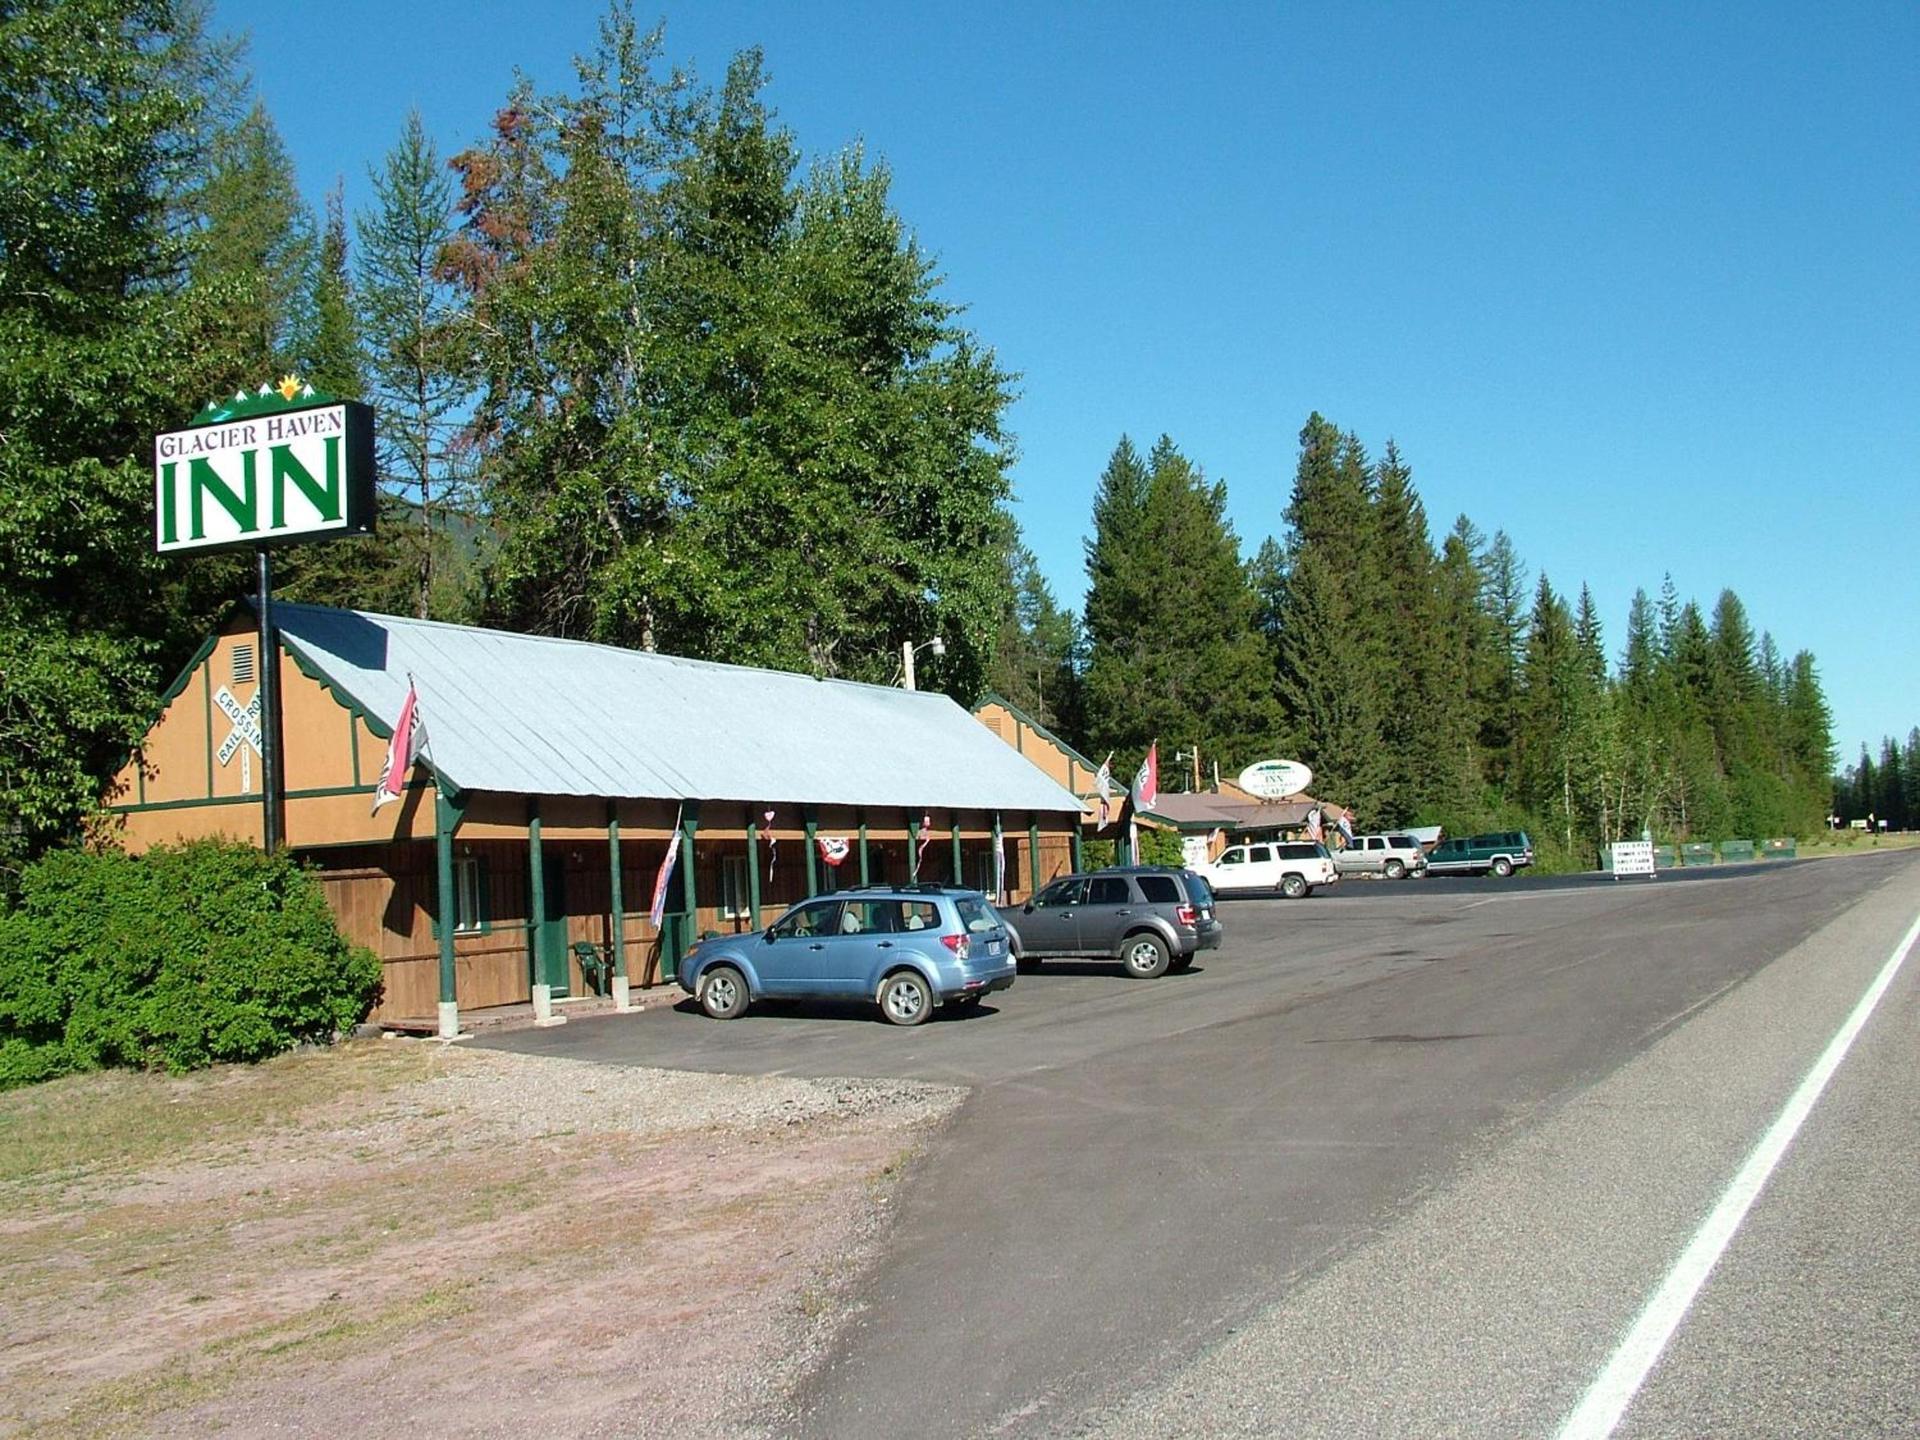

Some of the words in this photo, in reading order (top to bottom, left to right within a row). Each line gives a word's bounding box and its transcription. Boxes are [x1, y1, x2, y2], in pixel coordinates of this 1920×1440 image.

[160, 426, 256, 457] GLACIER
[267, 411, 342, 441] HAVEN
[160, 435, 344, 544] INN
[219, 692, 262, 746] CROSSIN
[218, 732, 242, 760] RAIL
[1265, 775, 1283, 783] INN
